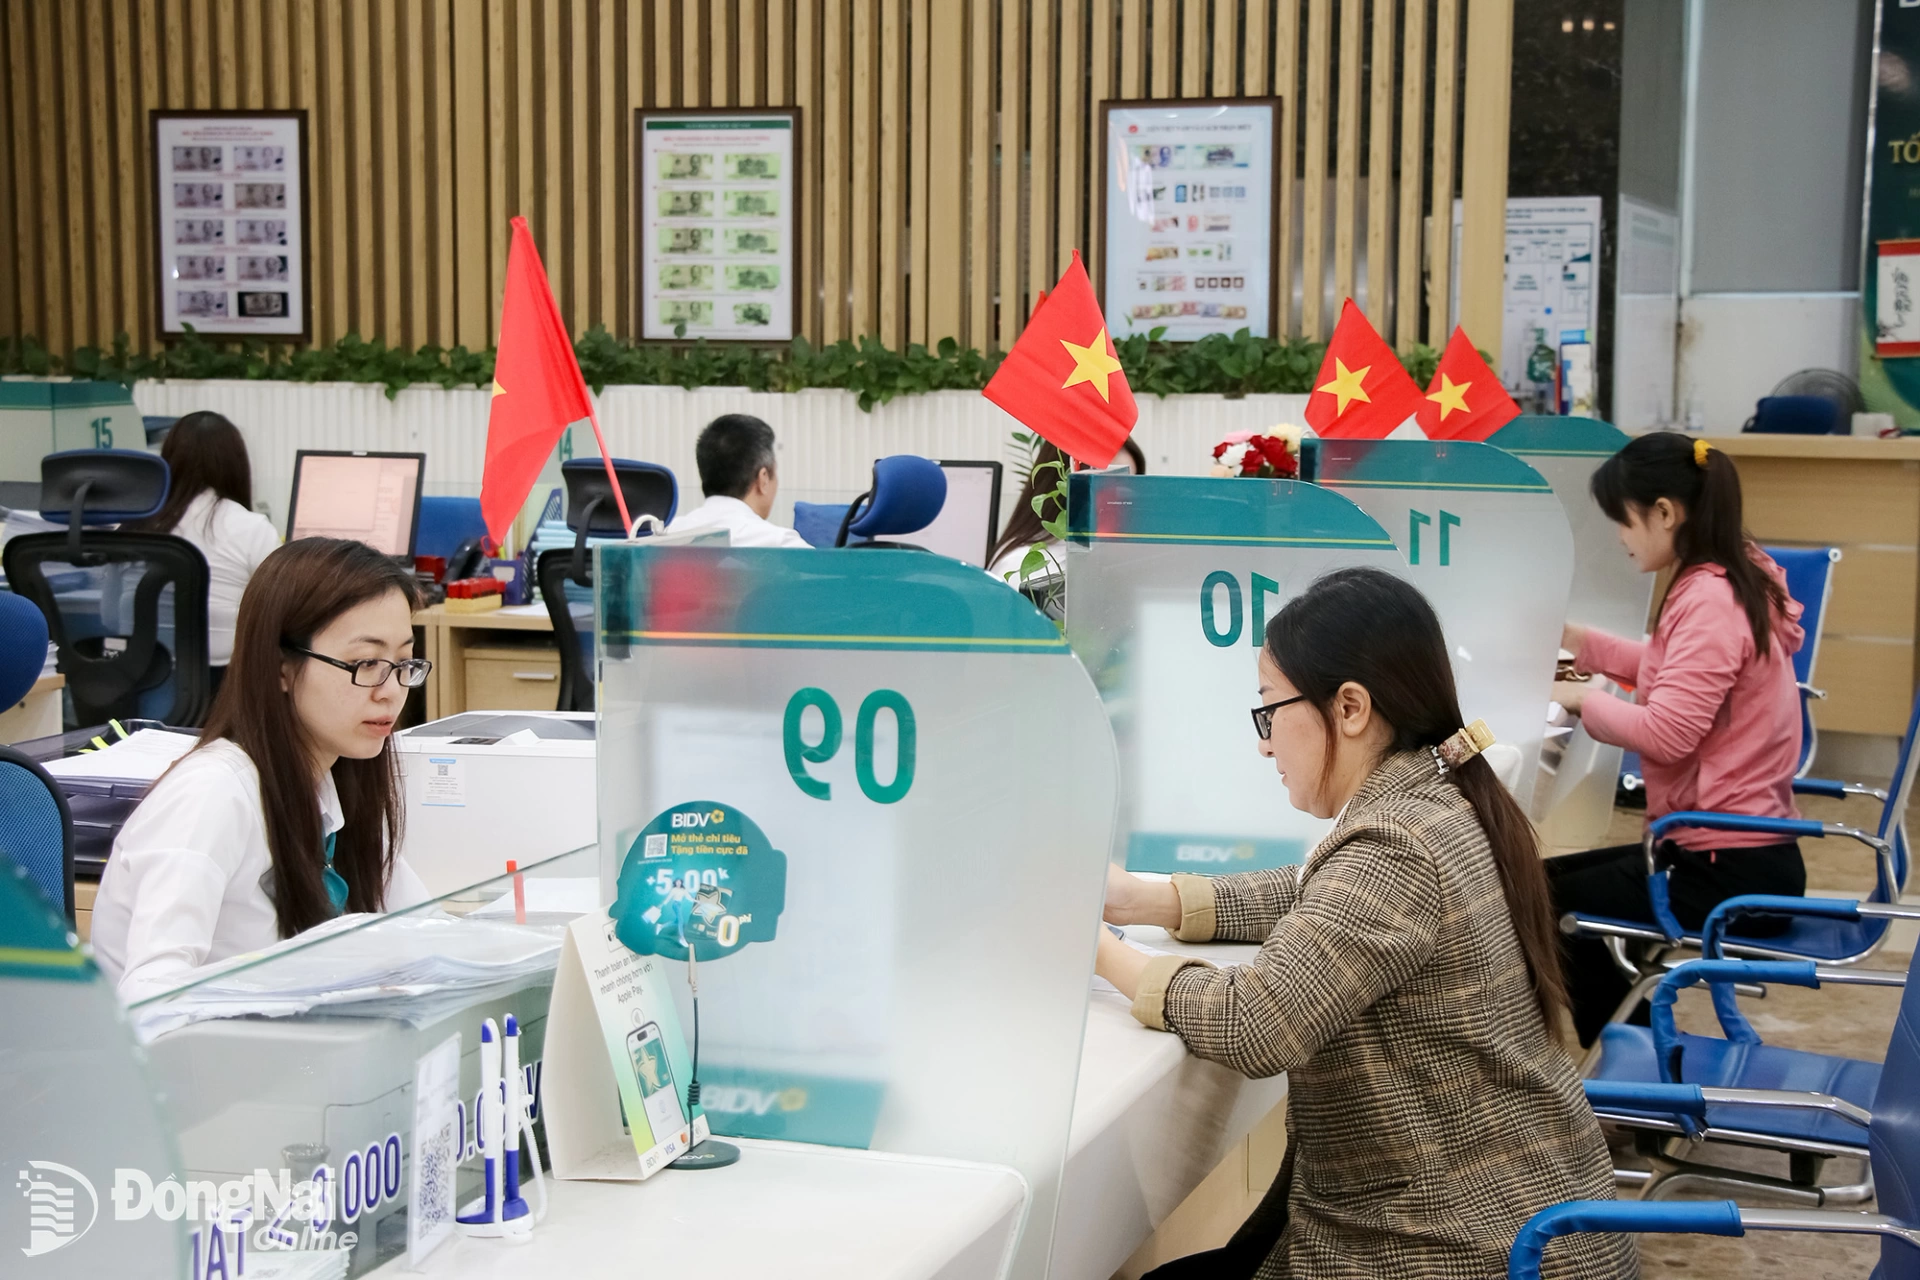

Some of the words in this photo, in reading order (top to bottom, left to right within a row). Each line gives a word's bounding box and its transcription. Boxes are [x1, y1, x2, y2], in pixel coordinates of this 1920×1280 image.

[91, 416, 113, 450] 15
[671, 812, 711, 828] BIDV
[705, 834, 721, 843] chi
[1176, 845, 1234, 863] BIDV
[700, 1085, 779, 1116] BIDV
[663, 1142, 677, 1156] VISA
